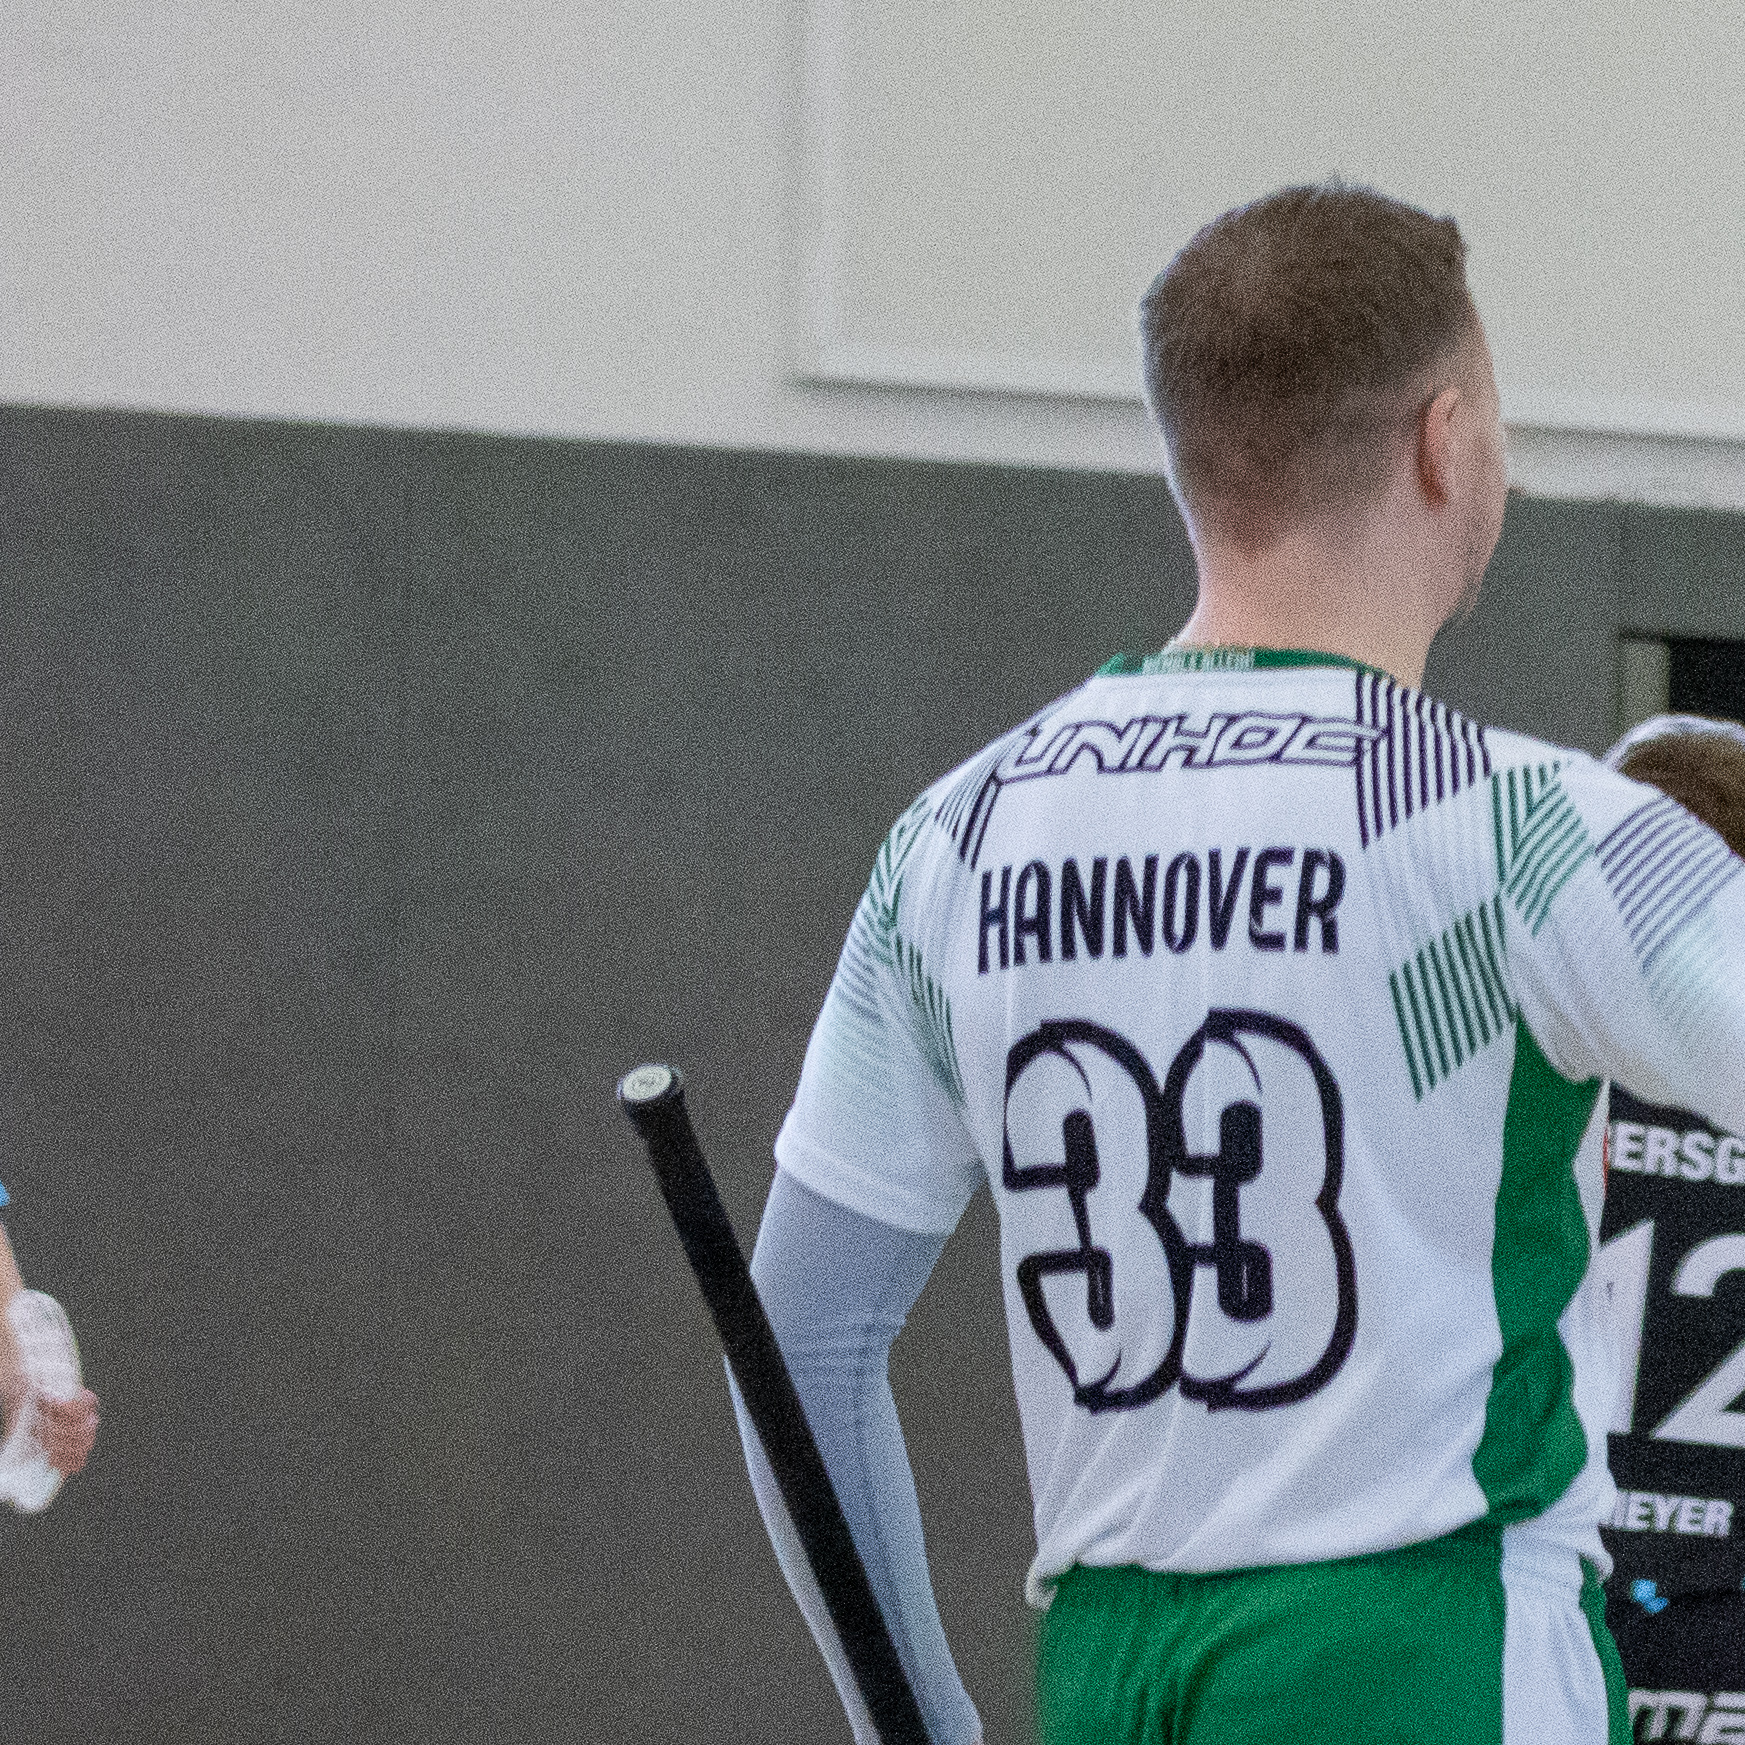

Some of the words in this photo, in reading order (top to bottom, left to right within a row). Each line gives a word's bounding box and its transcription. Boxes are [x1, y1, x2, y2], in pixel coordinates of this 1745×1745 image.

[998, 711, 1388, 785] UNIHOC
[978, 847, 1346, 975] HANNOVER
[1001, 1007, 1358, 1413] 33
